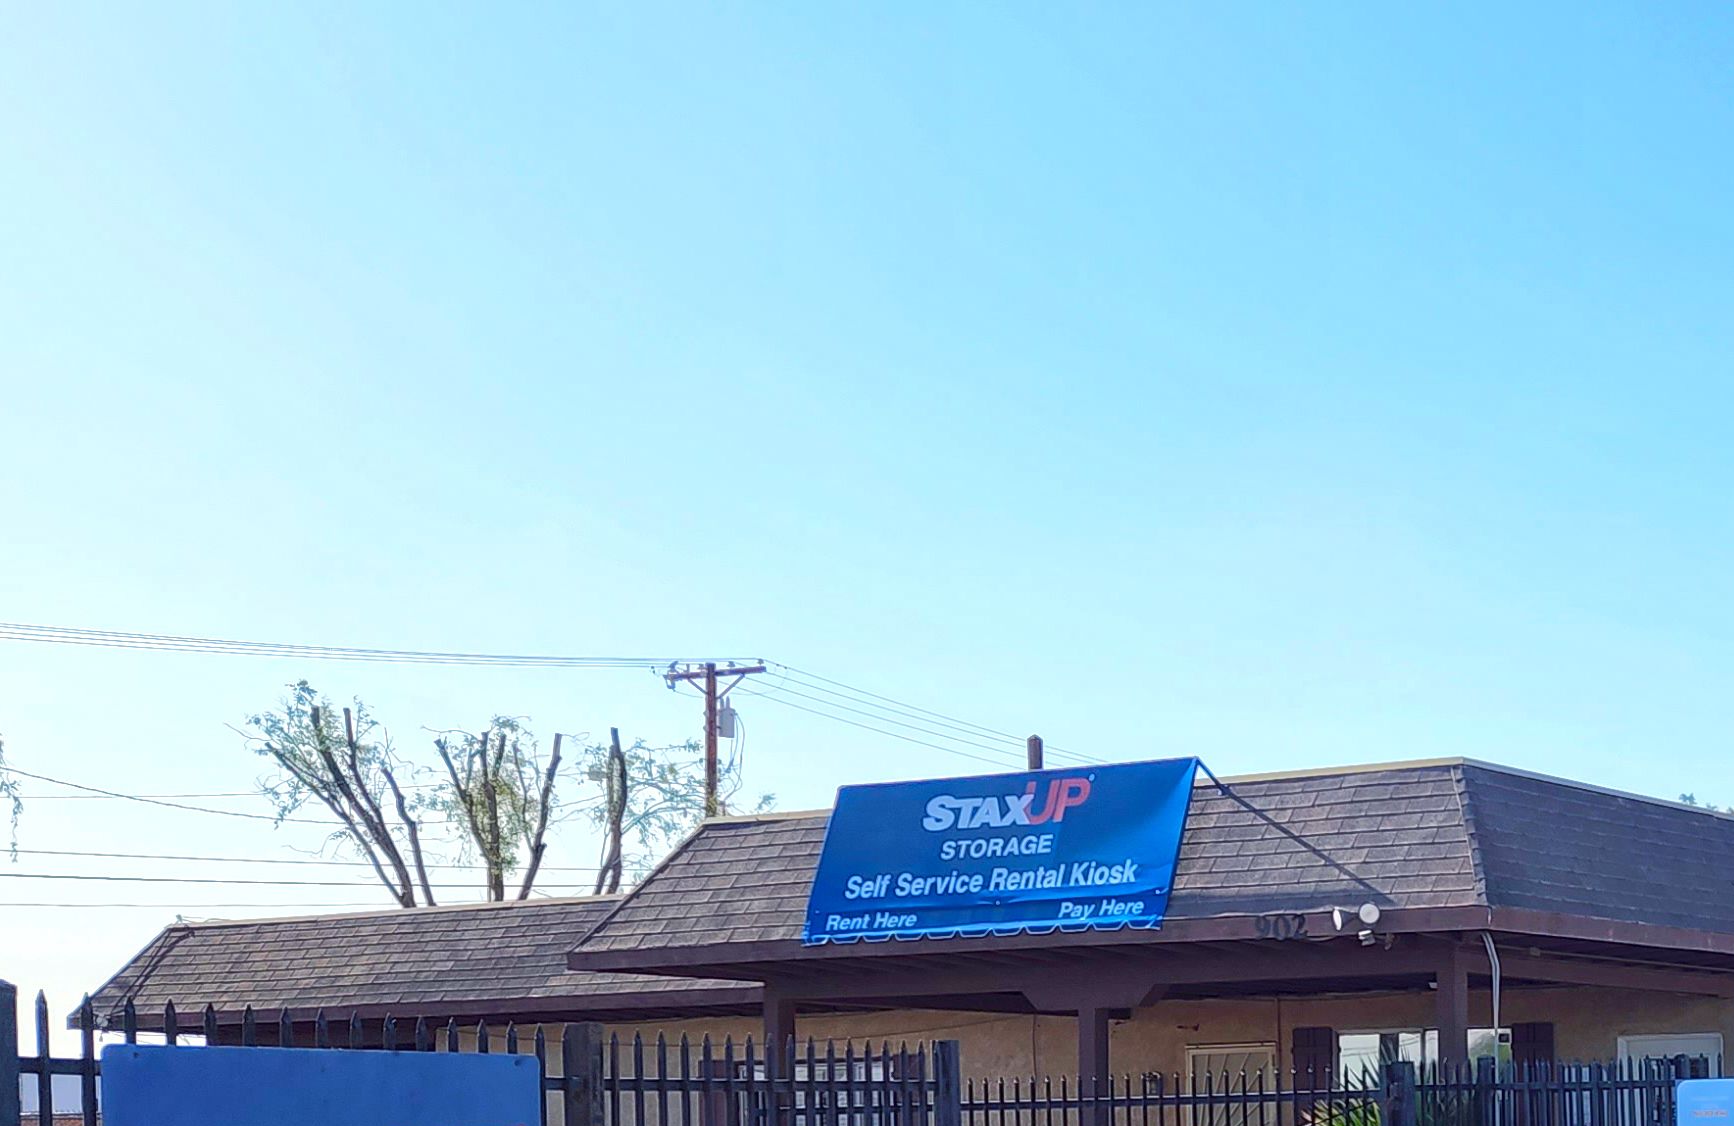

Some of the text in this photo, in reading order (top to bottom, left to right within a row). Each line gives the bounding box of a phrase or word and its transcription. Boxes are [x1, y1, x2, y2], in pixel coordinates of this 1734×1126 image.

[922, 777, 1090, 831] STAXUP
[940, 834, 1054, 861] STORAGE
[845, 859, 1138, 899] Self Service Rental Kiosk
[825, 912, 917, 931] Rent Here
[1058, 899, 1144, 920] Pay Here
